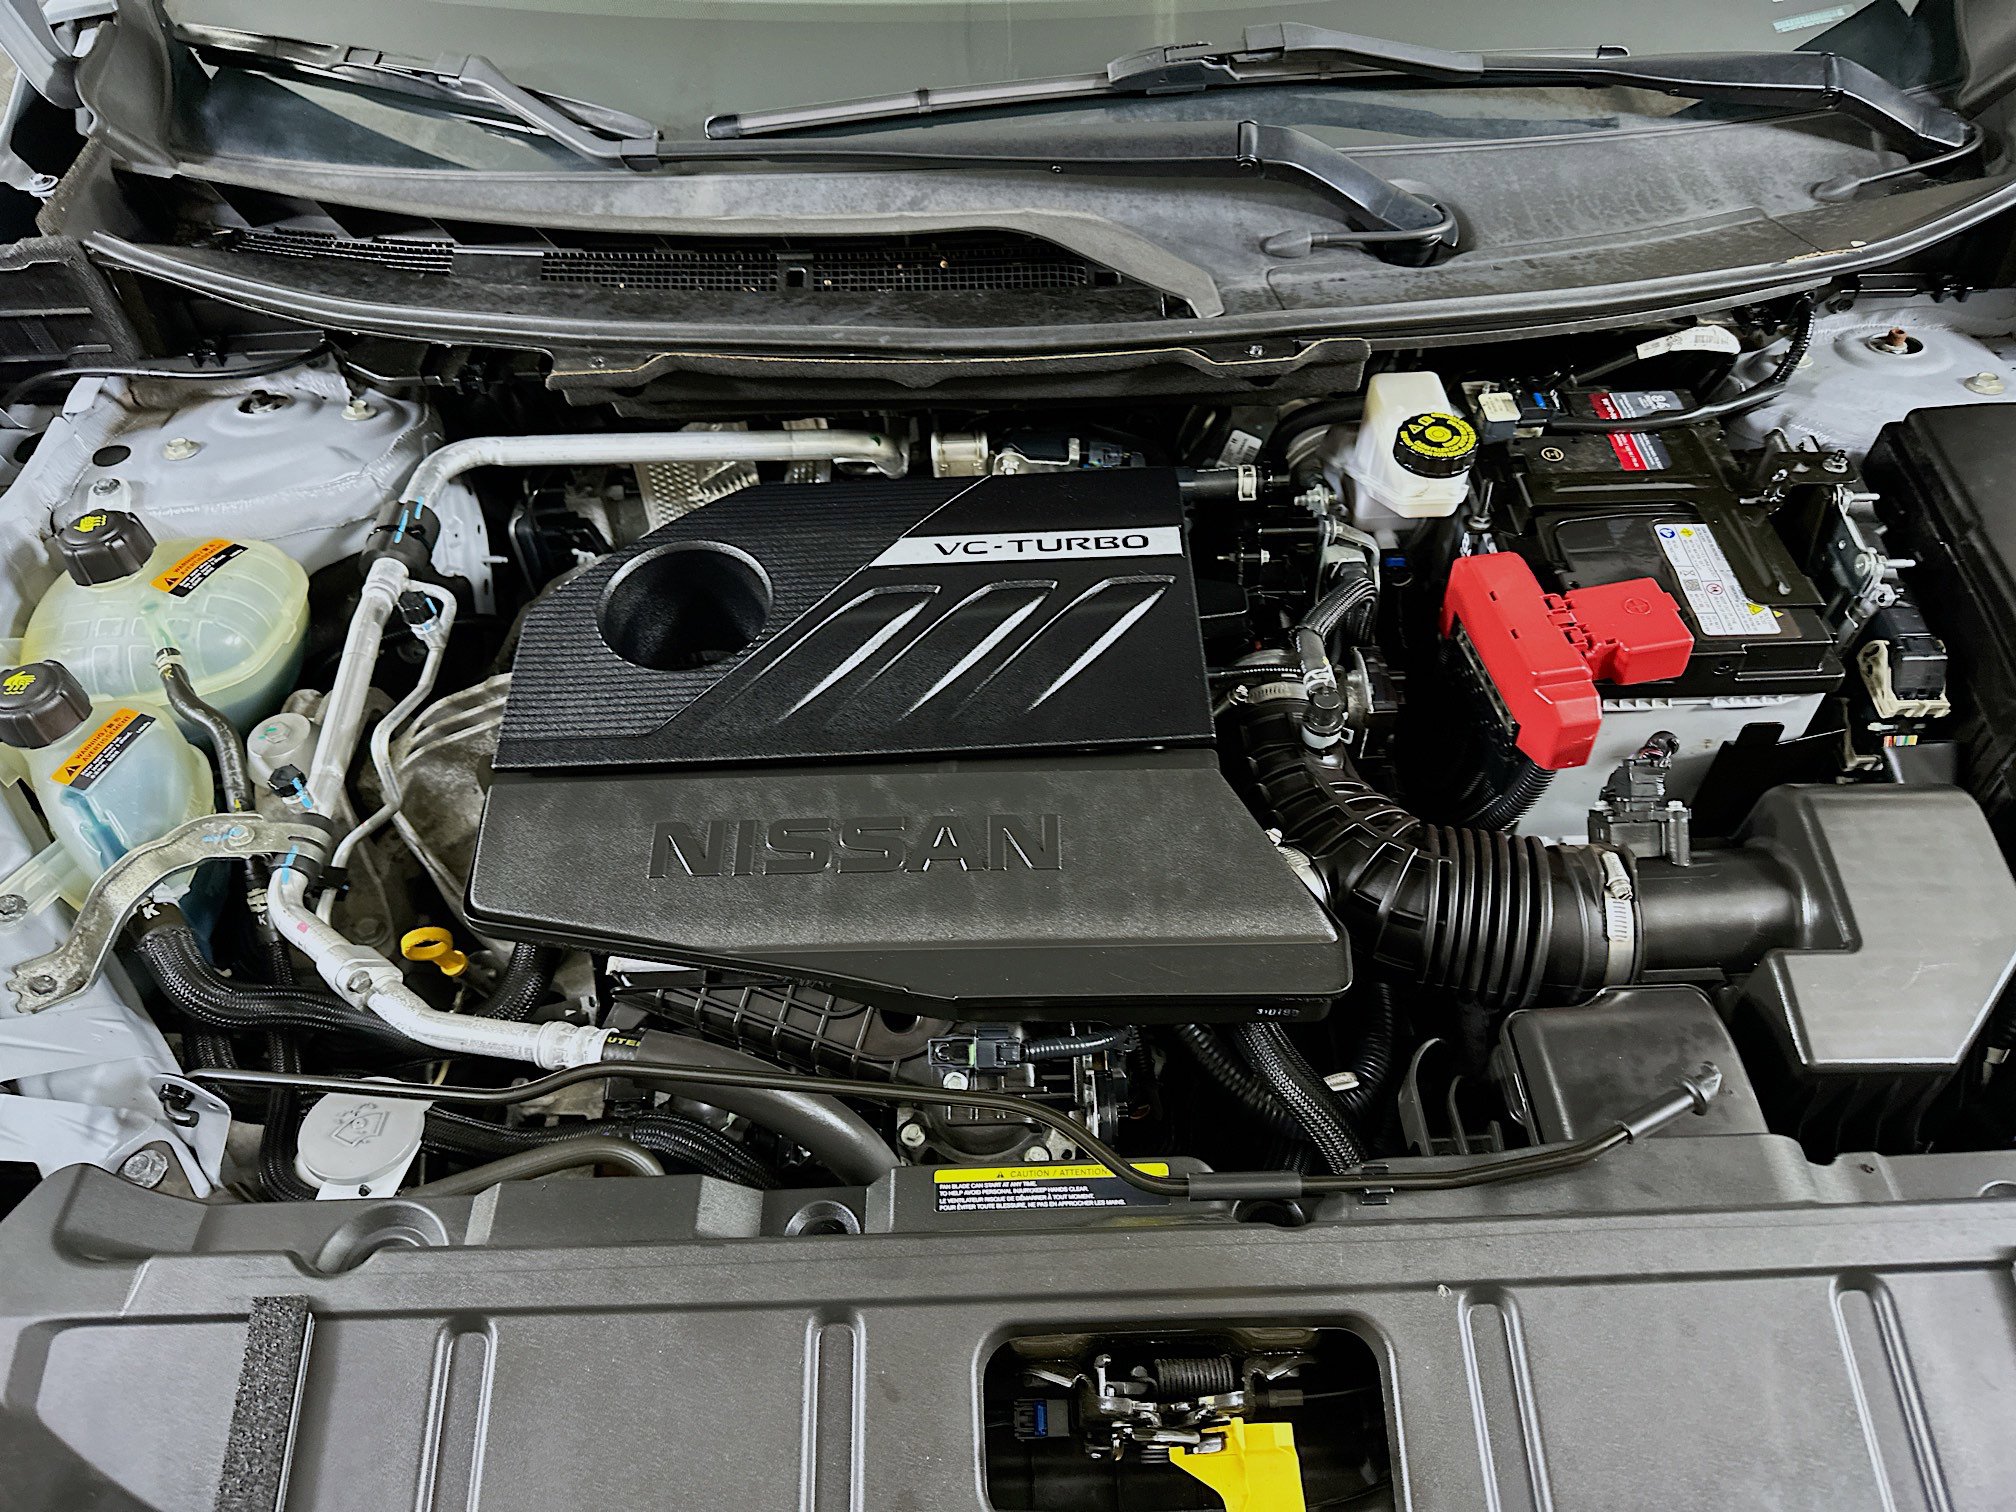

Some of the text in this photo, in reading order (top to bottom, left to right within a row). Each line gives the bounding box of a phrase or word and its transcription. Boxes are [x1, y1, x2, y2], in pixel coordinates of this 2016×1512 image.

[934, 534, 1149, 556] VC-TURBO
[75, 732, 105, 760] WARNING
[82, 715, 132, 763] AVERTISSEMENT
[647, 813, 1063, 878] NISSAN
[142, 903, 161, 920] K
[1010, 1169, 1050, 1178] CAUTION
[1059, 1167, 1109, 1176] ATTENTION
